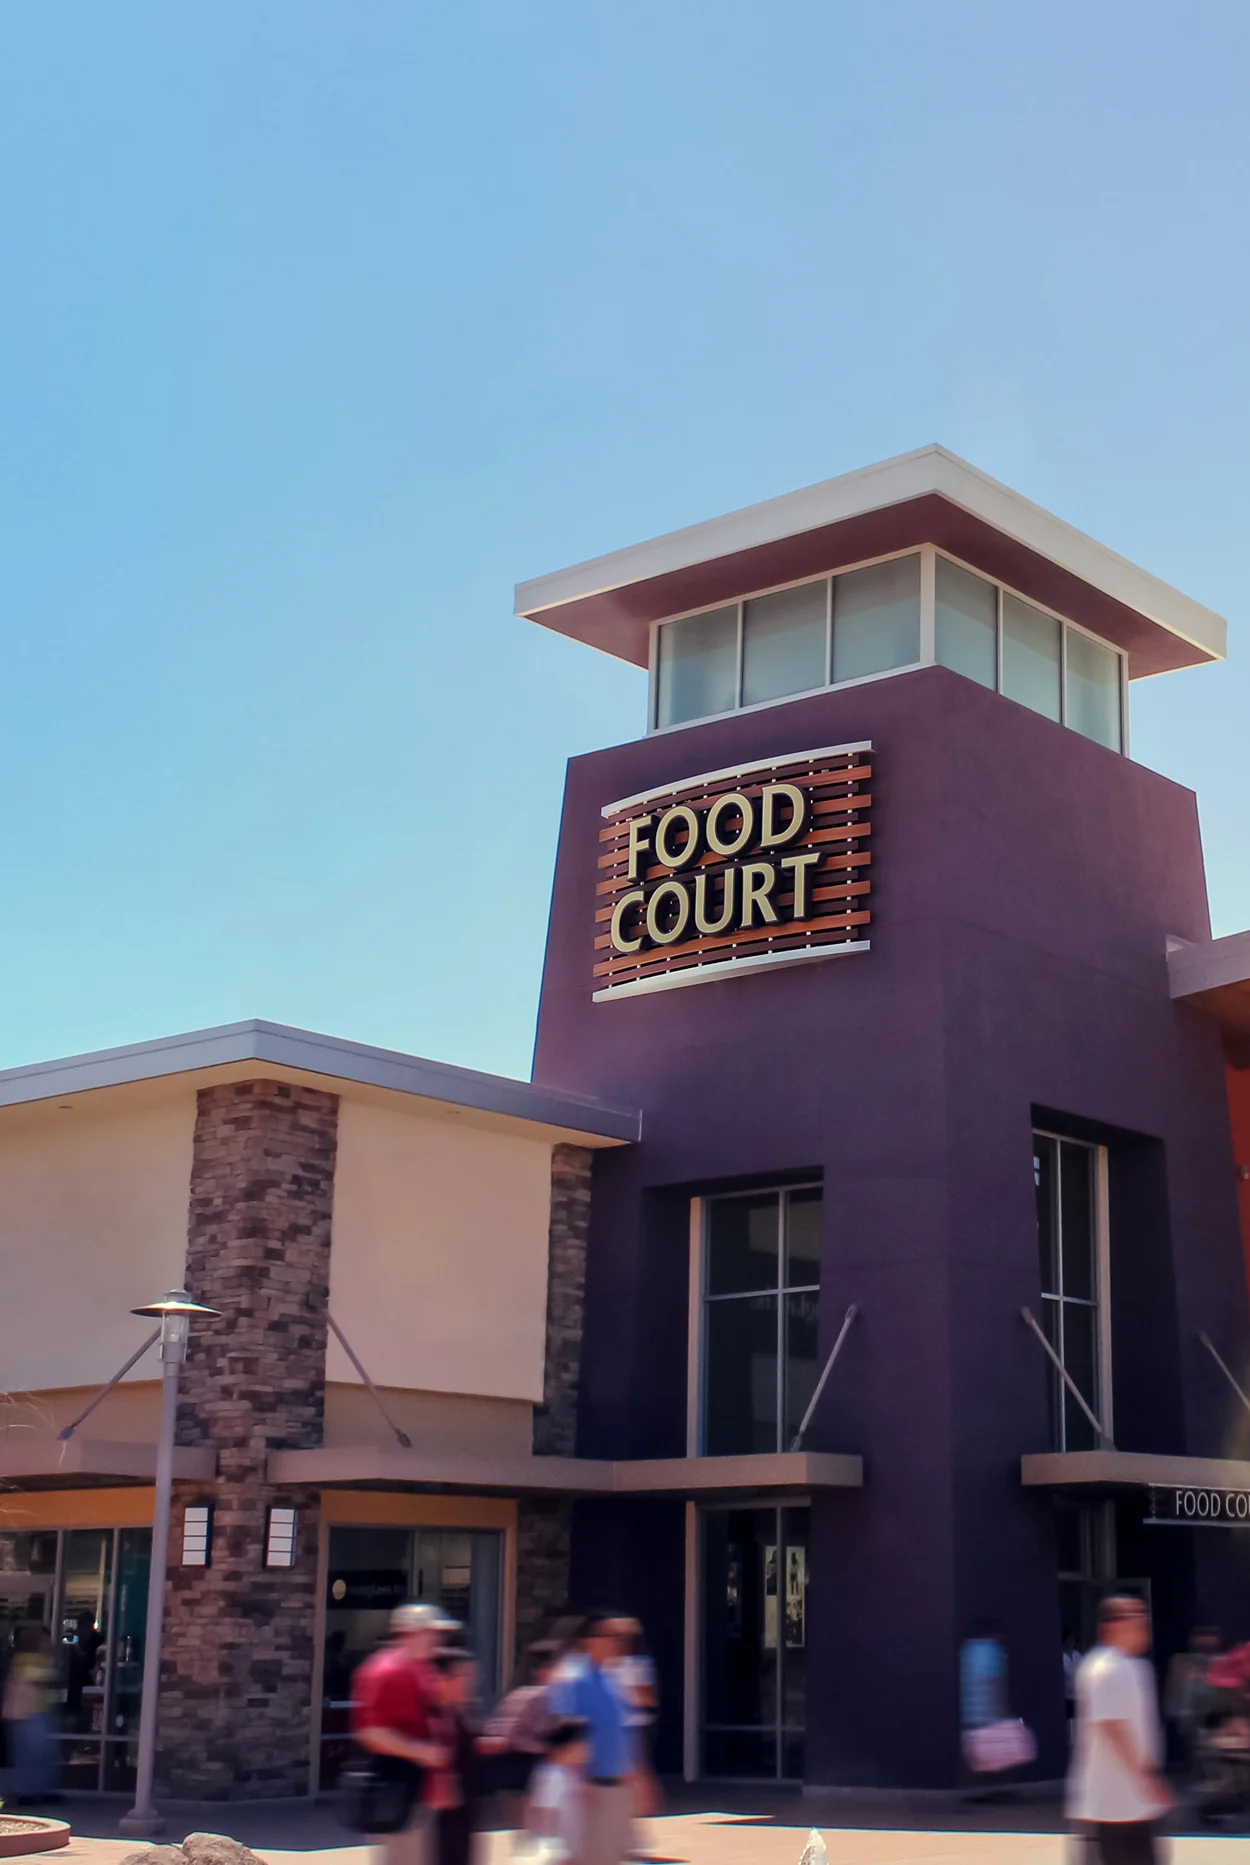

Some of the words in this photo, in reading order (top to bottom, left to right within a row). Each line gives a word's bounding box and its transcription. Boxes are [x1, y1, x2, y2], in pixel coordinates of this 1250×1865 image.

[626, 783, 806, 881] FOOD
[610, 851, 822, 953] COURT
[1175, 1490, 1221, 1516] FOOD
